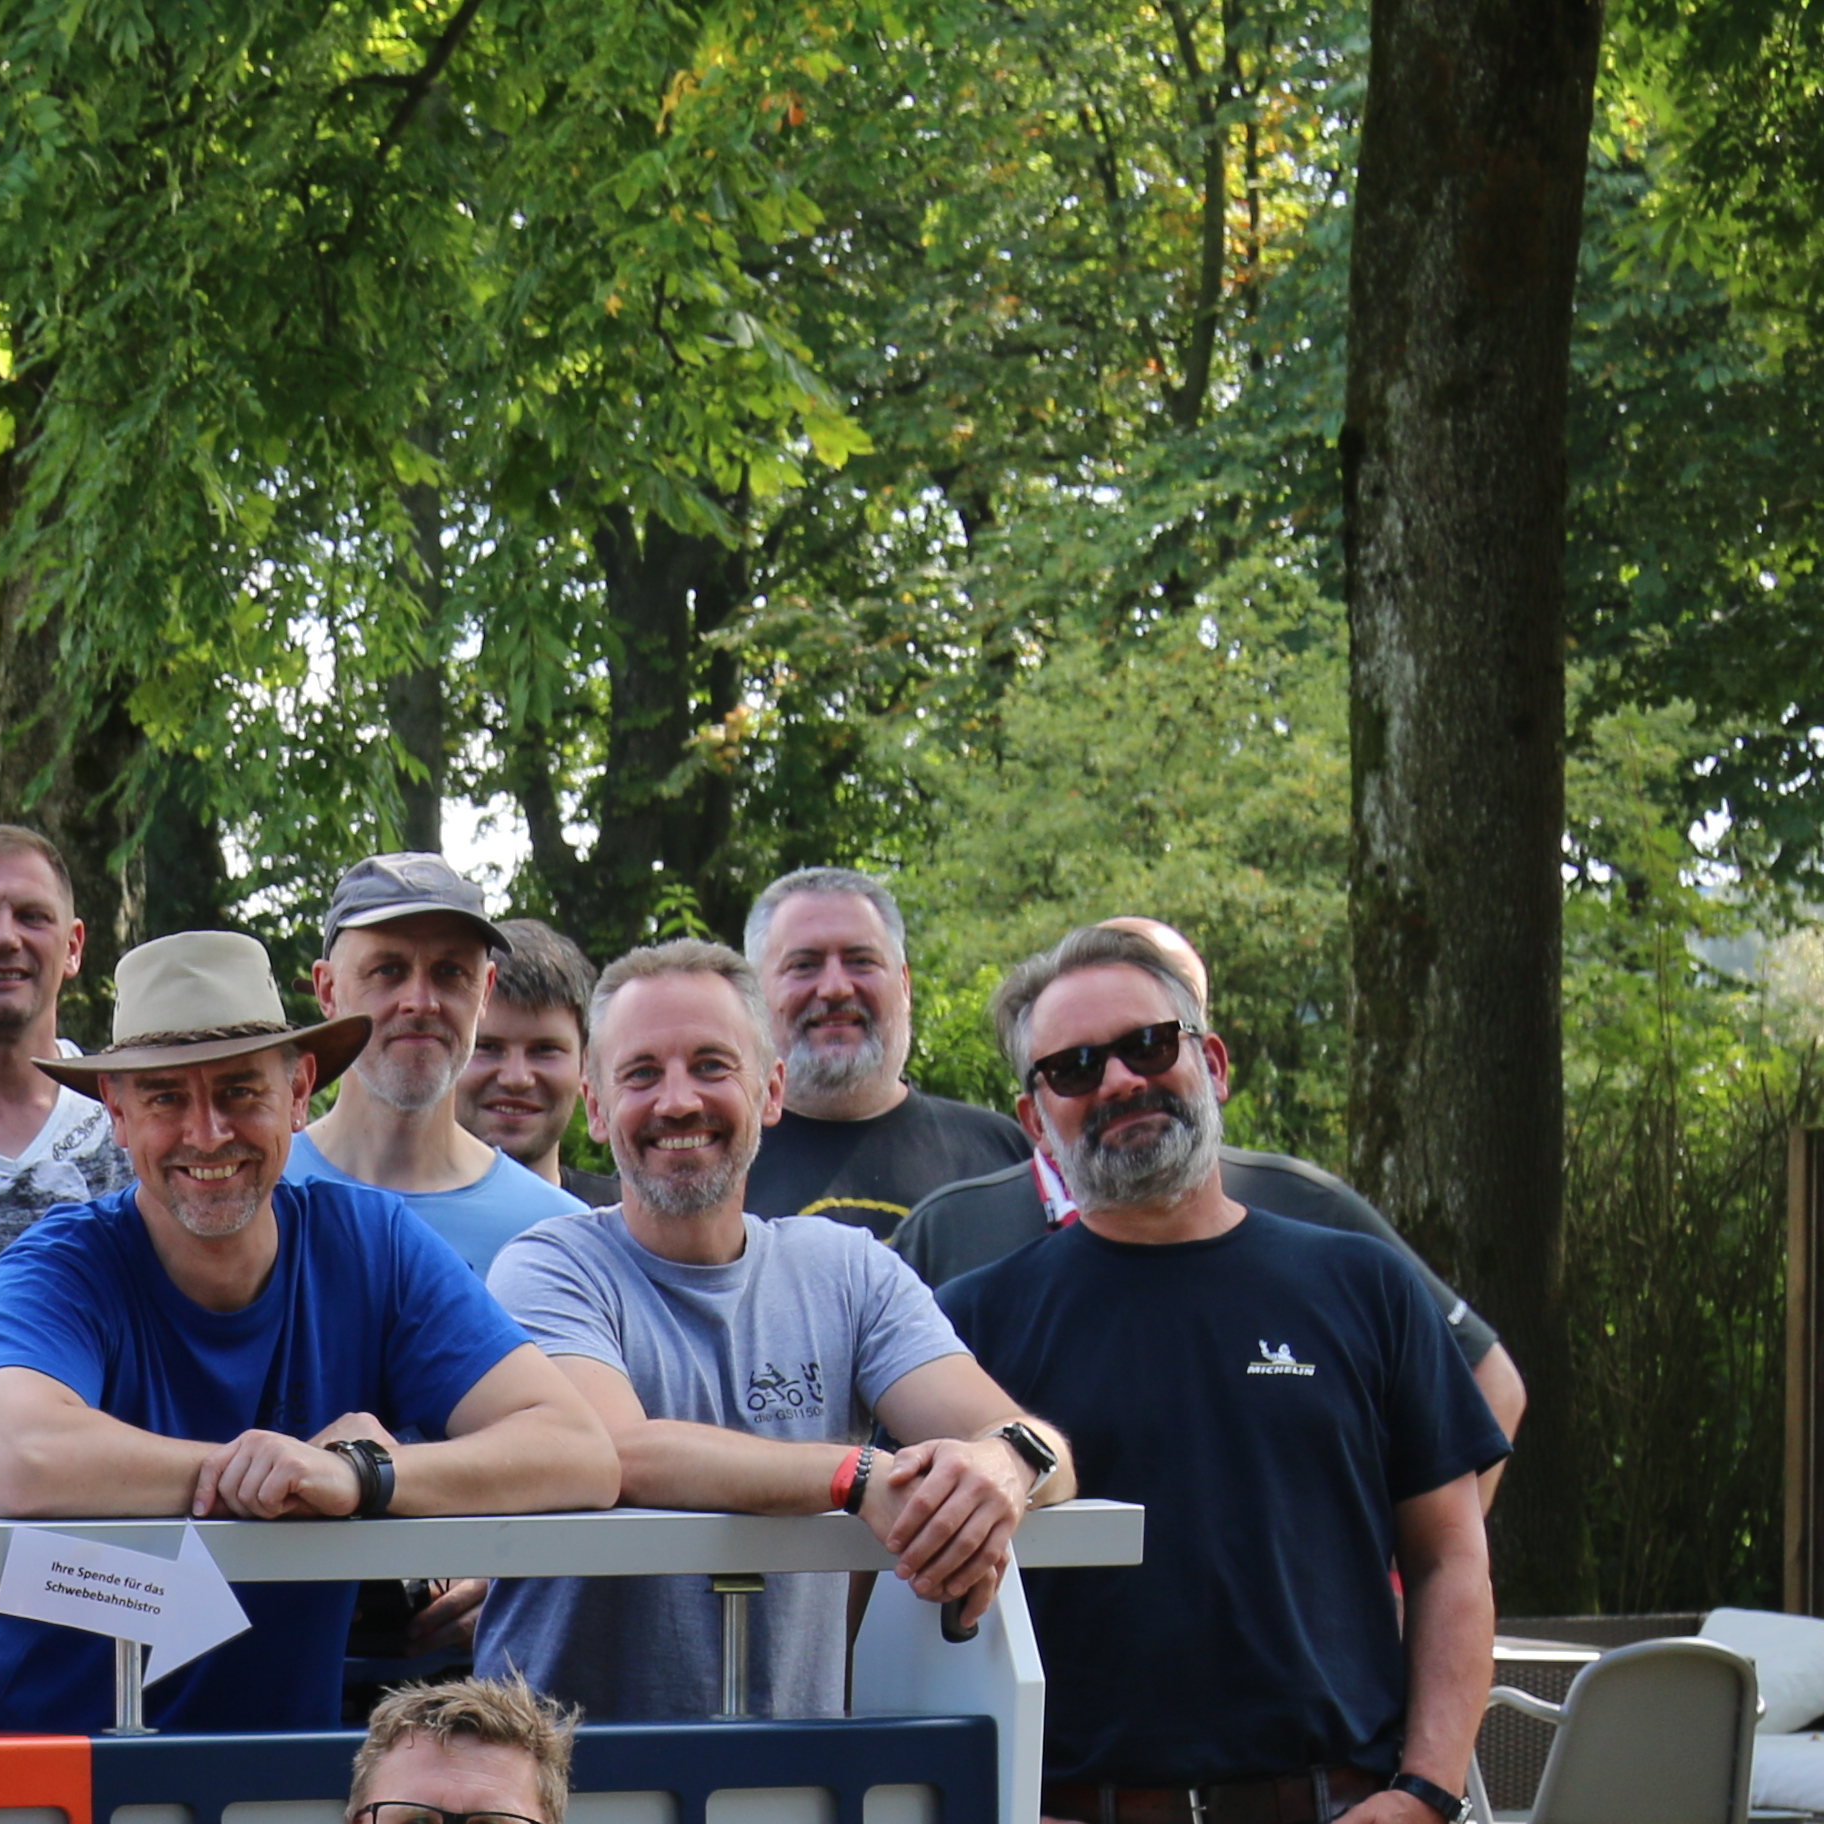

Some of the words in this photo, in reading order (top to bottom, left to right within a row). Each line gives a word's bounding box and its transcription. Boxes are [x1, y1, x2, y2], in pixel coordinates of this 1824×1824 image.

[1247, 1365, 1315, 1377] MICHELIN
[775, 1405, 822, 1420] GS1150
[51, 1561, 74, 1575] Ihre
[77, 1566, 121, 1585] Spende
[124, 1576, 142, 1590] für
[144, 1582, 165, 1596] das
[44, 1580, 161, 1615] Schwebebahnbistro
